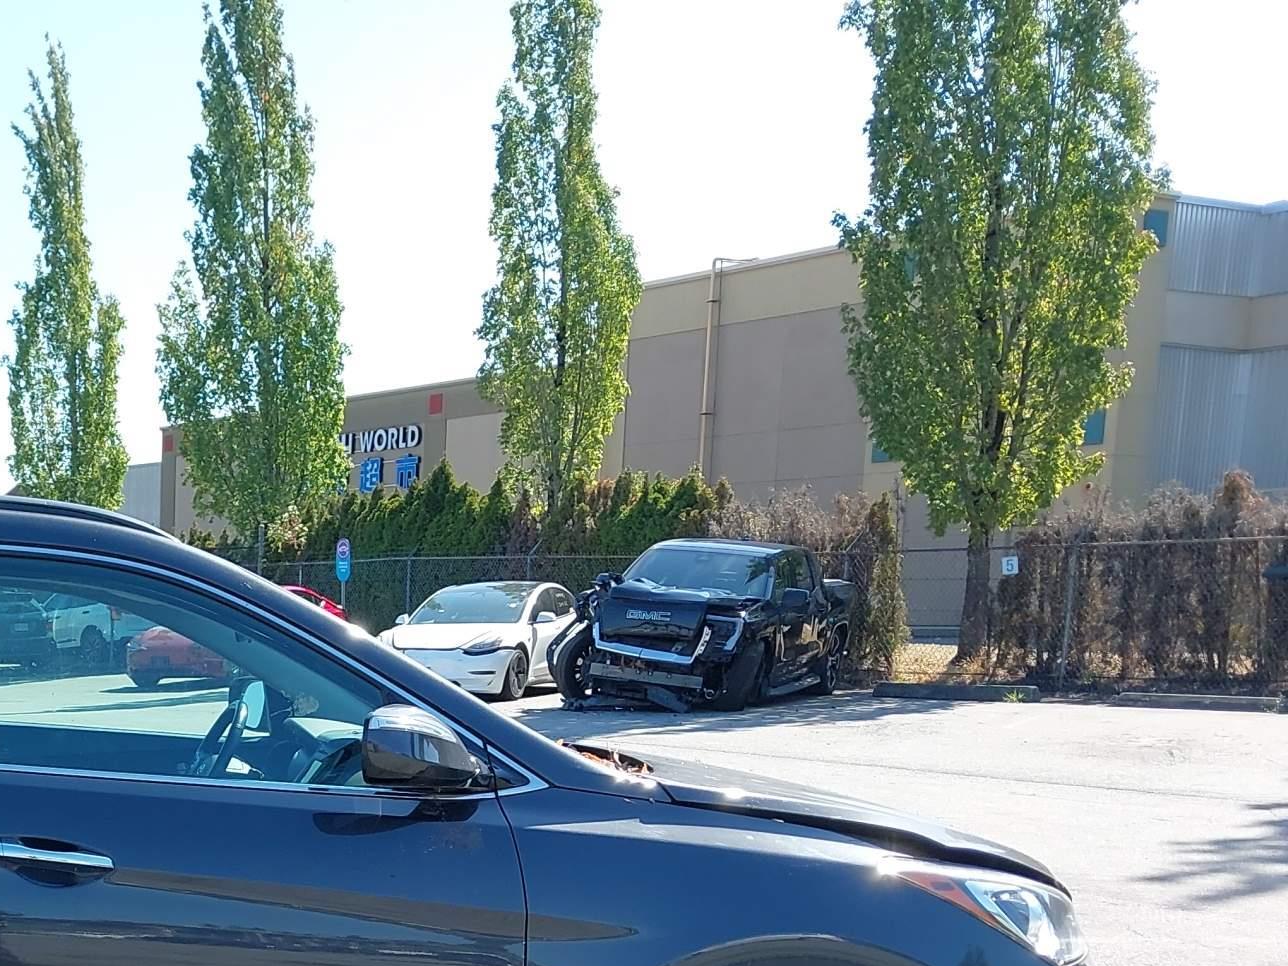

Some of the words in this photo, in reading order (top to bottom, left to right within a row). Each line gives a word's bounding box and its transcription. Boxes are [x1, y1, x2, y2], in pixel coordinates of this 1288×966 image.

[359, 425, 422, 452] WORLD
[1006, 559, 1014, 572] 5
[625, 609, 672, 622] GMC
